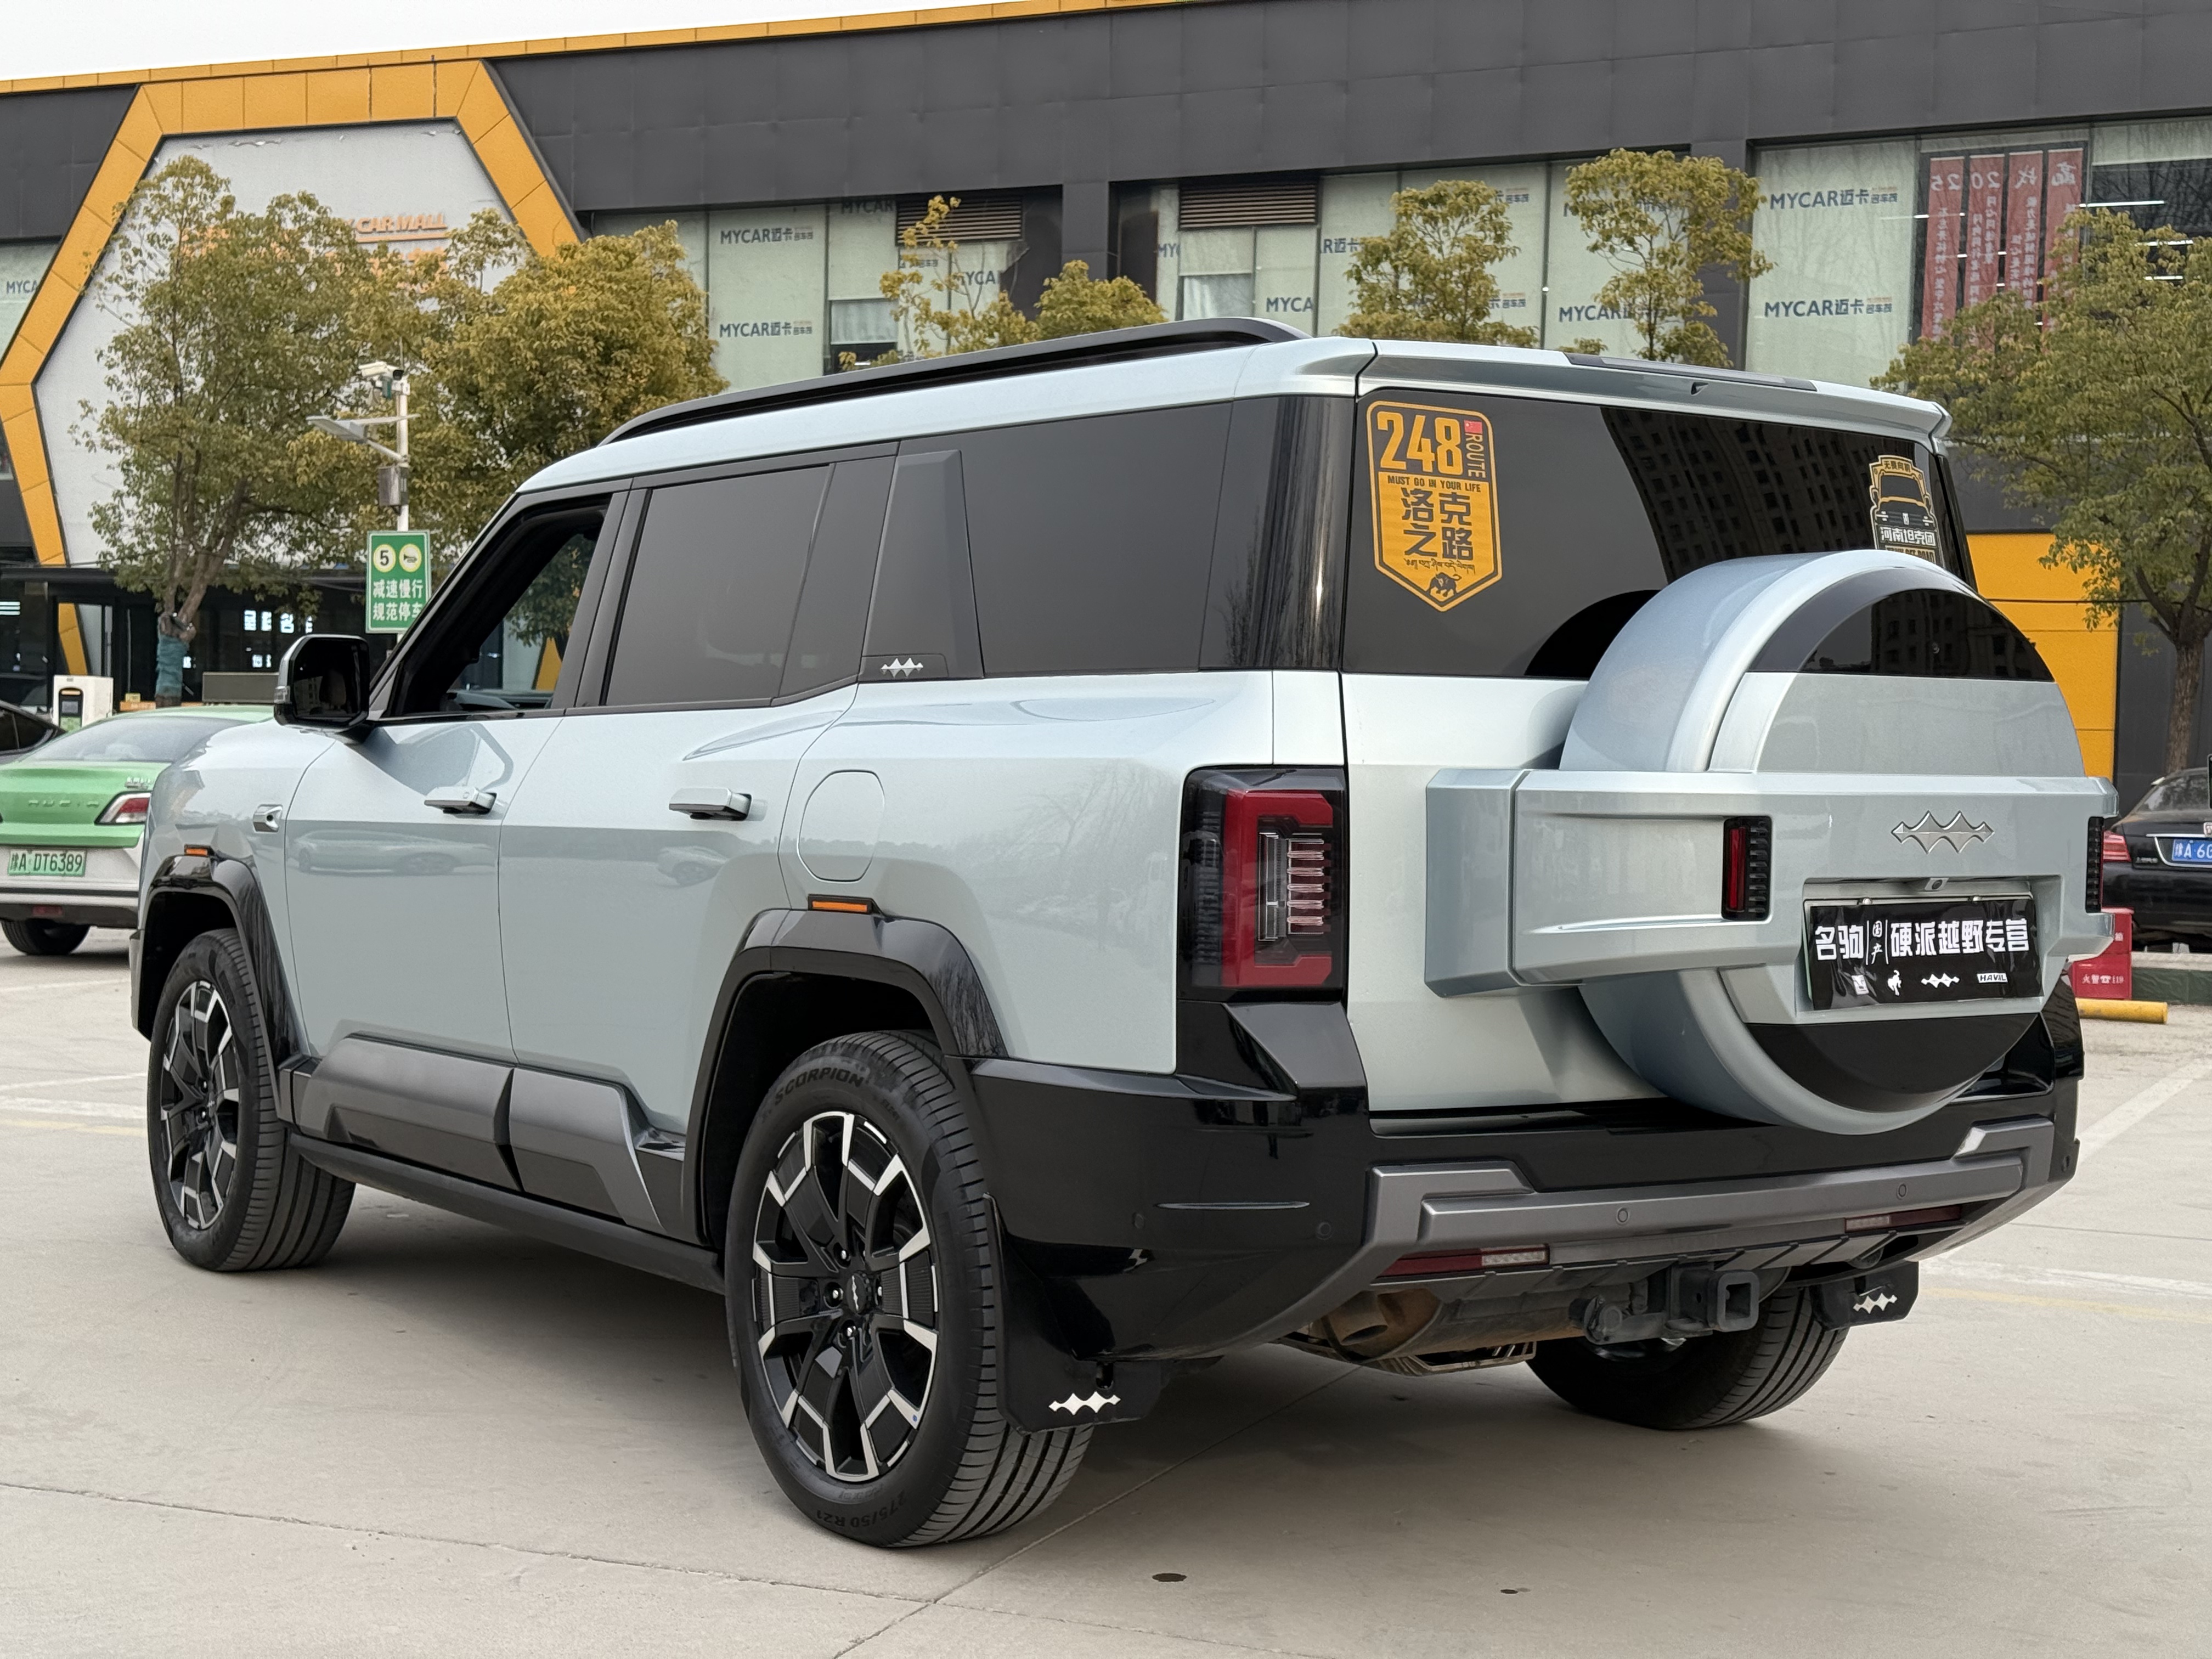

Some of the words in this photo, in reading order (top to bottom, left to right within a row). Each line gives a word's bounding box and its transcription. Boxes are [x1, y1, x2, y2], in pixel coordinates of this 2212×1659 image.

[1376, 411, 1463, 476] 248
[1465, 433, 1486, 478] ROUTE
[1388, 475, 1410, 486] MUST
[1414, 477, 1425, 487] GO
[1429, 479, 1437, 488] IN
[1441, 481, 1462, 490] YOUR
[1465, 483, 1481, 492] LIFE
[1401, 487, 1472, 526] 洛克
[1403, 523, 1474, 561] 之路
[1880, 527, 1937, 546] 河南坦克团
[380, 550, 390, 566] 5
[373, 579, 424, 599] 减速慢行
[373, 602, 423, 621] 规范停车
[1891, 918, 2029, 957] 硬派越野专营
[774, 1066, 866, 1107] SCORPION
[816, 1509, 846, 1527] R21
